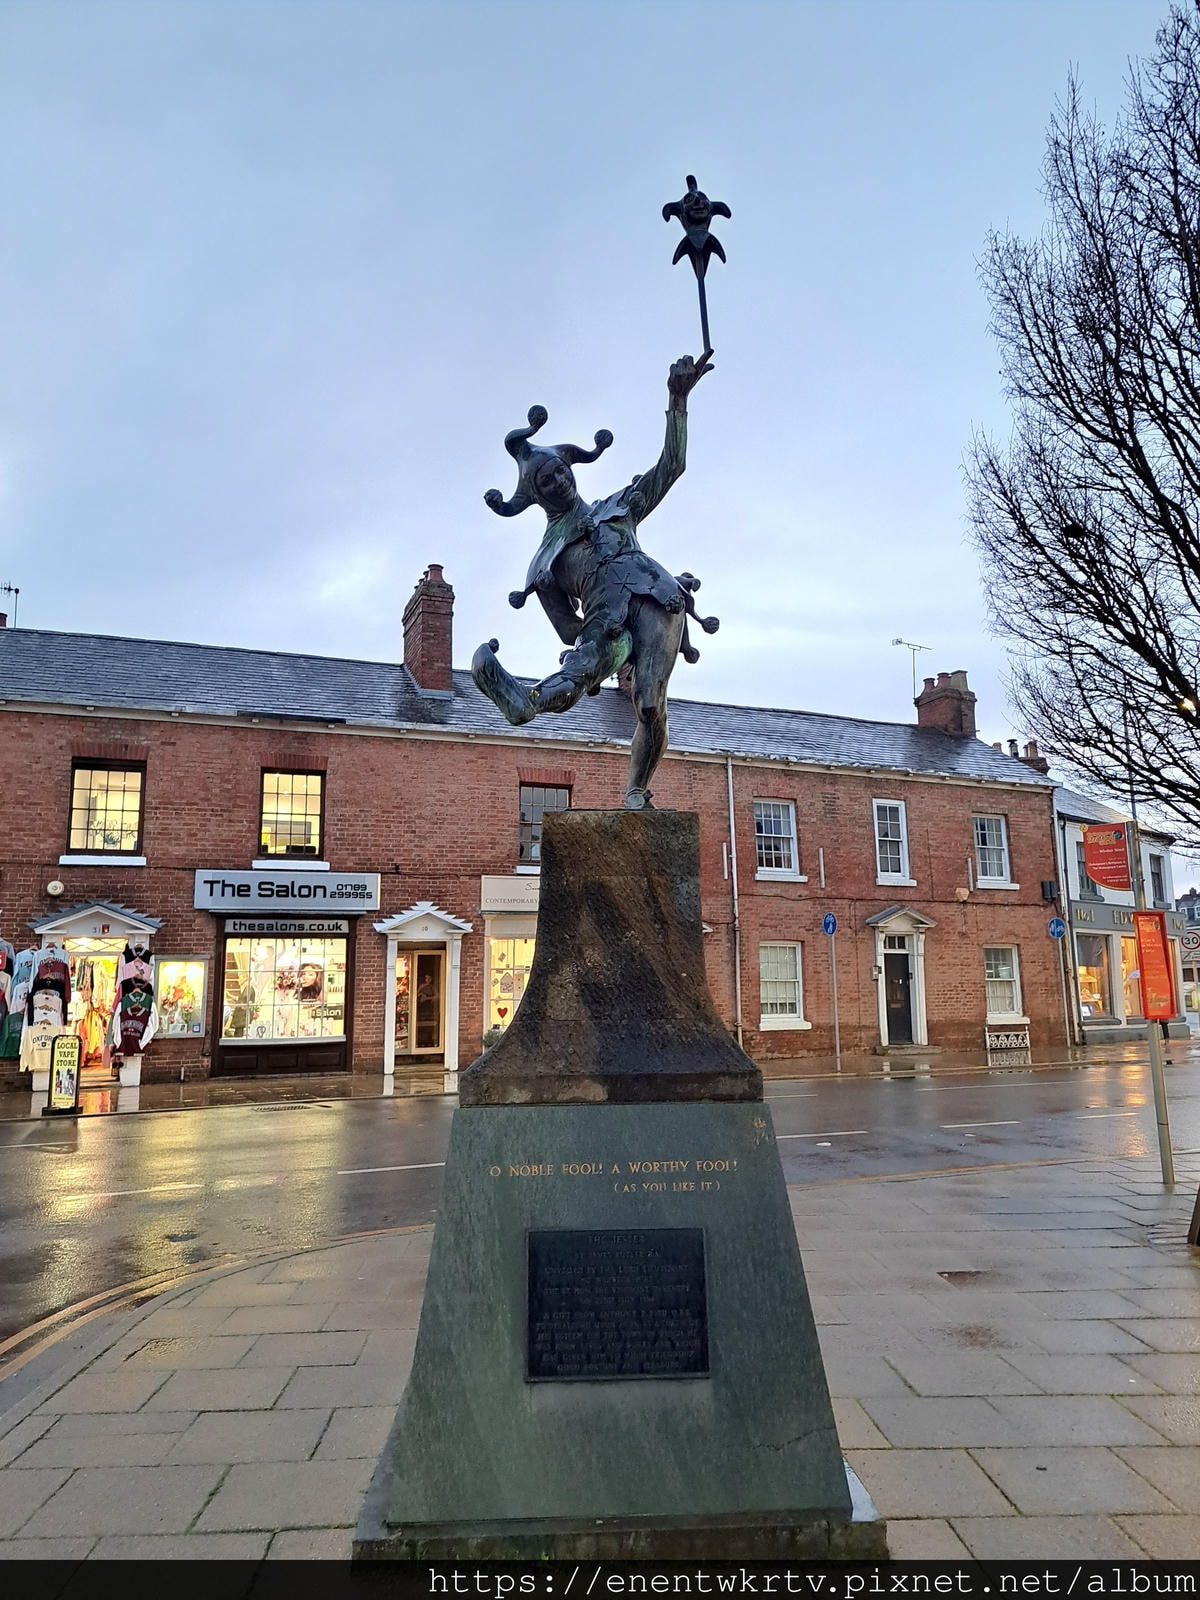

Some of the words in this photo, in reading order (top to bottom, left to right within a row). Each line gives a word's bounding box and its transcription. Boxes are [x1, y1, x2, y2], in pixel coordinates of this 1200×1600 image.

[203, 880, 251, 898] The
[258, 881, 327, 899] Salon
[329, 891, 373, 899] 299955
[232, 921, 343, 932] thesalons.co.uk
[1184, 936, 1199, 945] 30
[32, 1034, 53, 1044] OXFOR
[57, 1042, 78, 1050] LOCAL
[56, 1059, 76, 1067] STORE
[489, 1165, 501, 1177] O
[510, 1164, 553, 1176] NOBLE
[562, 1163, 603, 1175] FOOL!
[611, 1163, 621, 1174] A
[628, 1161, 690, 1174] WORTHY
[696, 1160, 738, 1172] FOOL!
[642, 1182, 667, 1192] YOU
[673, 1182, 695, 1192] LIKE
